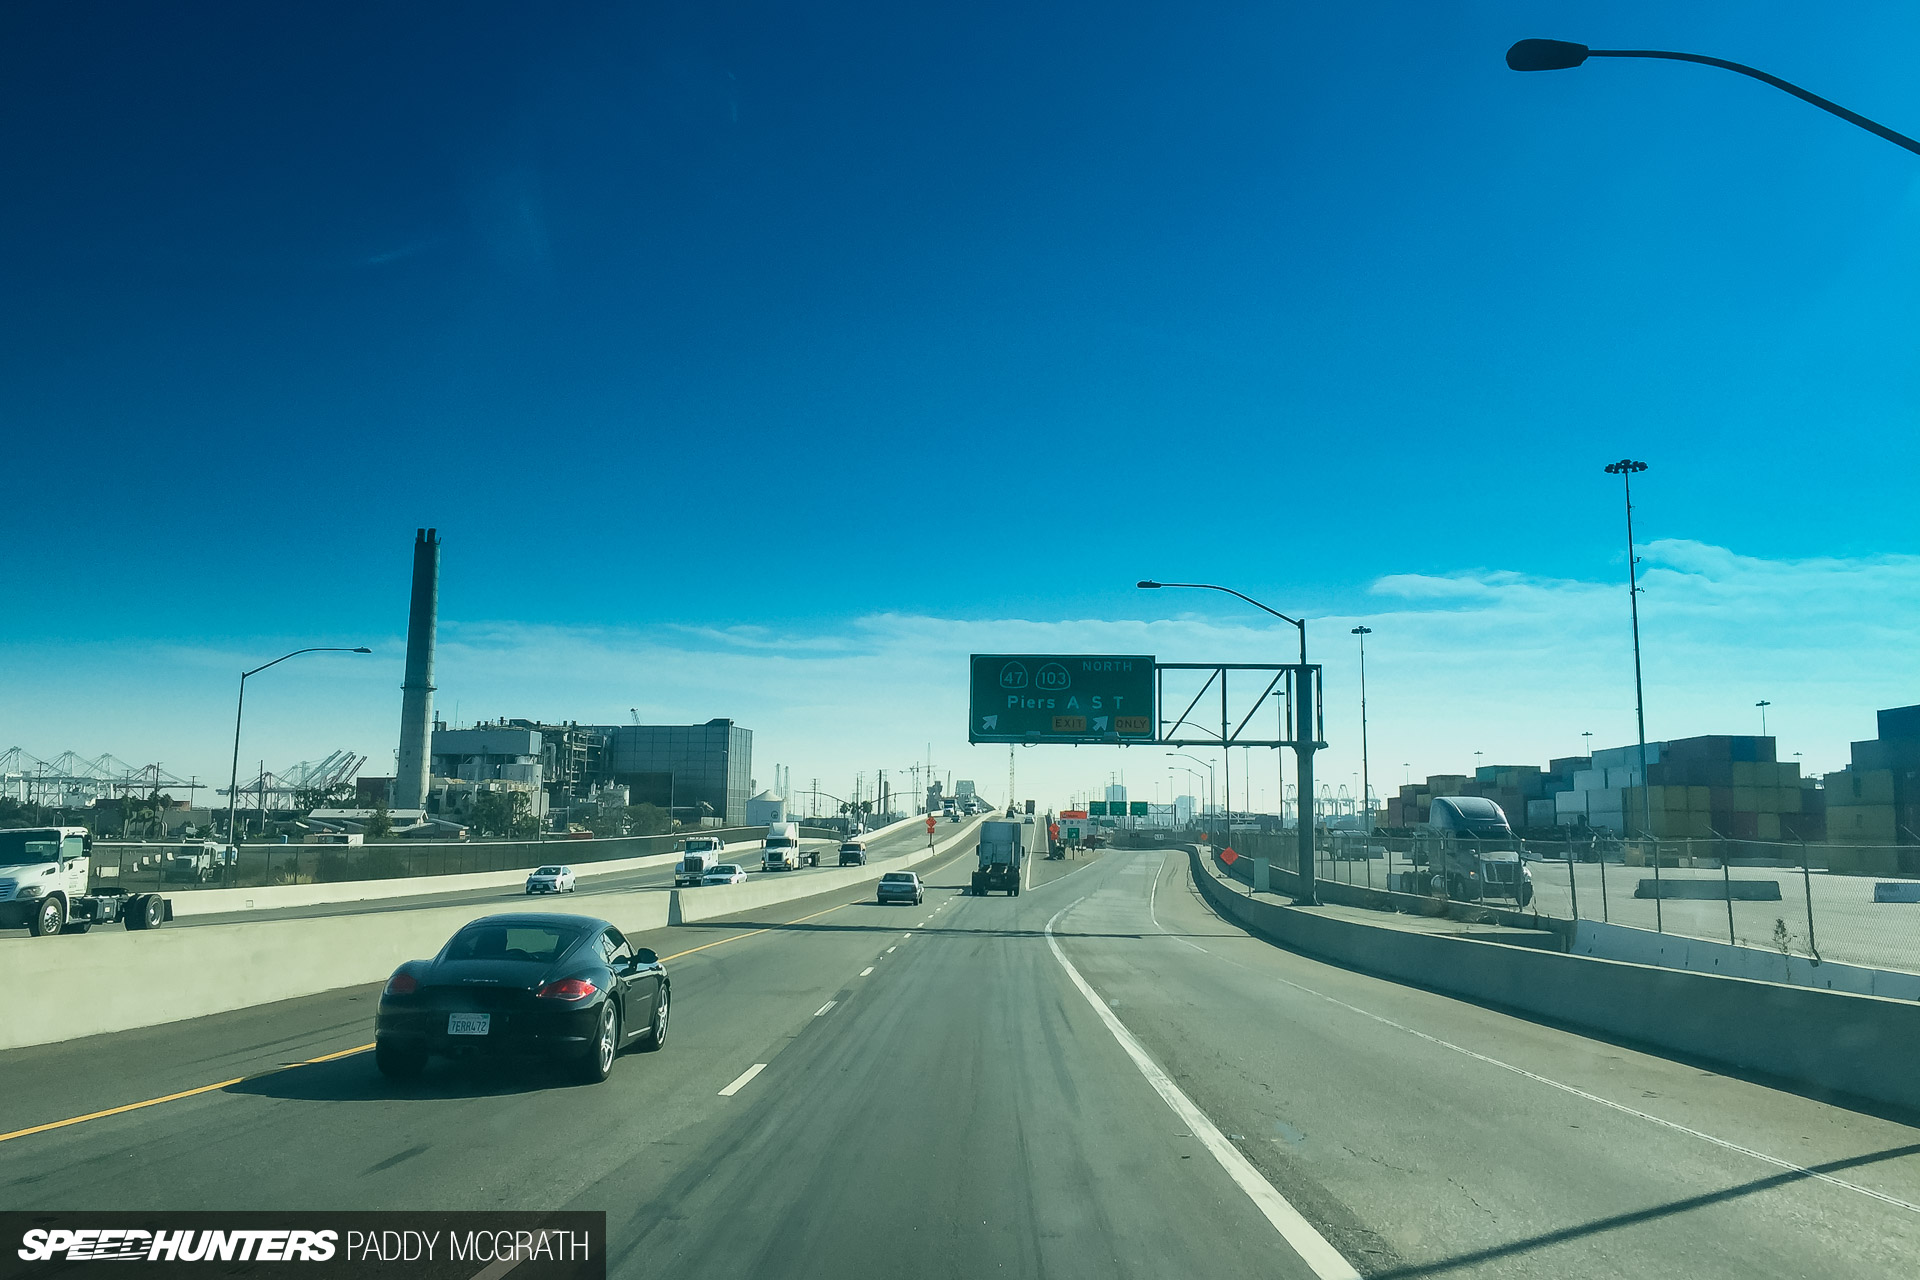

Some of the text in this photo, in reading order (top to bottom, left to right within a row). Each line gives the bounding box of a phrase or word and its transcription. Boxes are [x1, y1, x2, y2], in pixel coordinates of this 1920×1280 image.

[1082, 661, 1132, 672] NORTH
[1003, 671, 1023, 684] 47
[1041, 672, 1066, 685] 103
[1007, 695, 1124, 709] Piers A S T
[1055, 718, 1147, 729] EXIT ONLY
